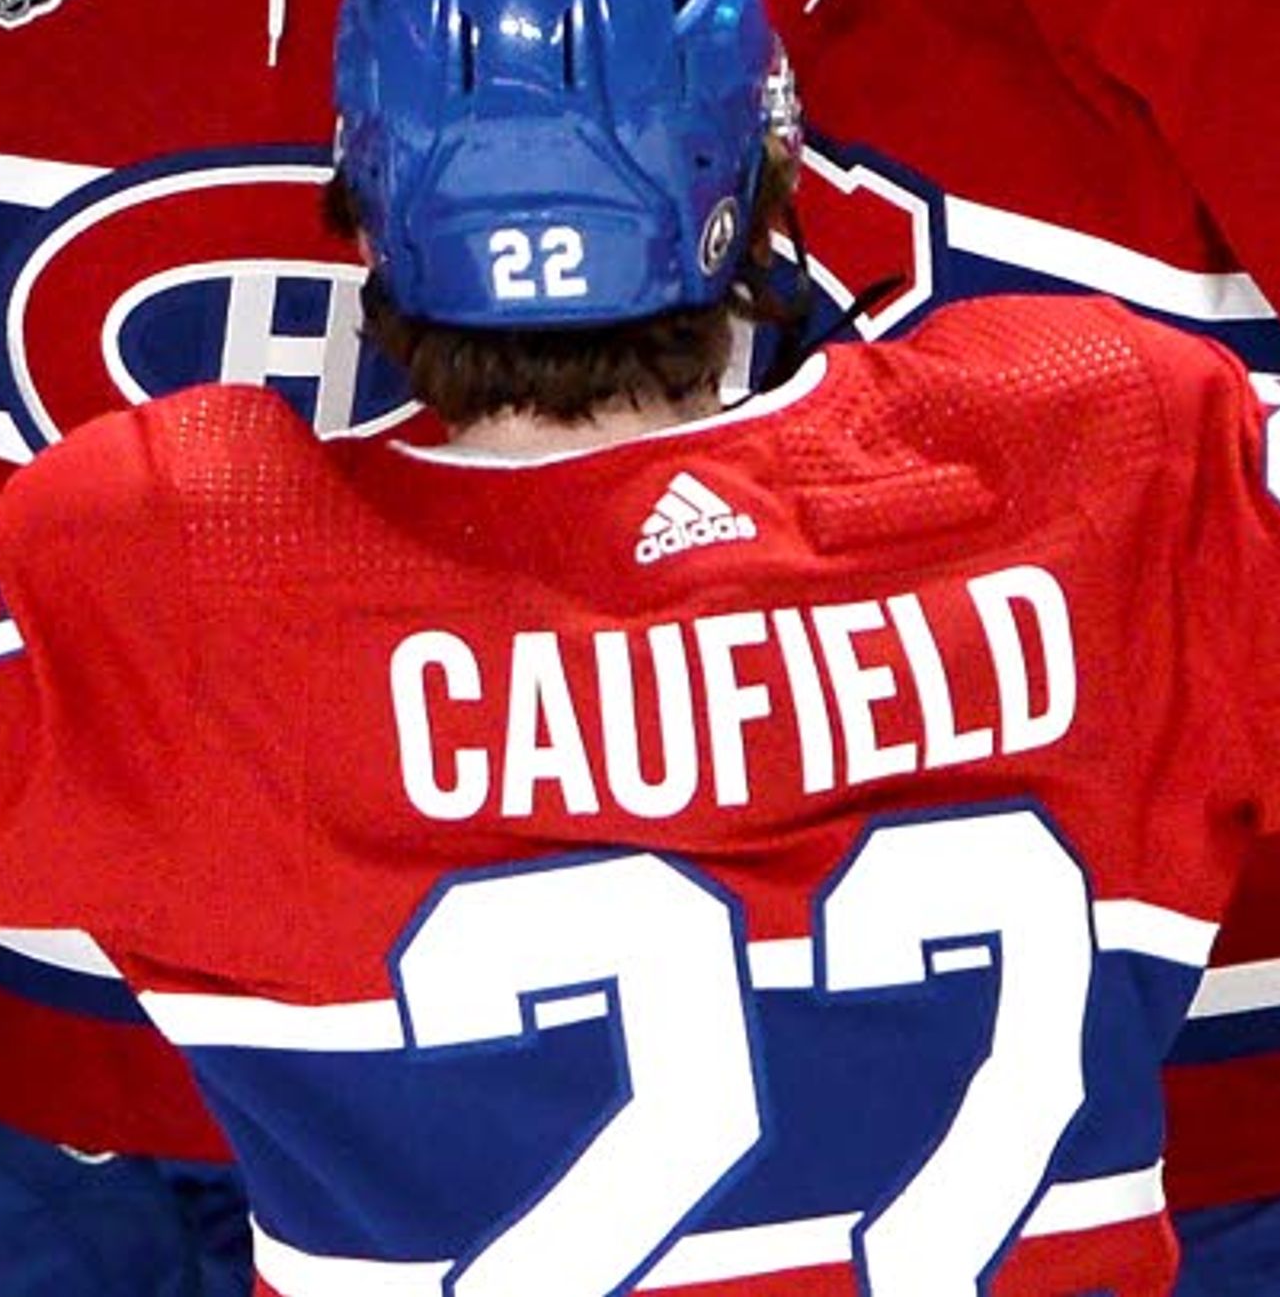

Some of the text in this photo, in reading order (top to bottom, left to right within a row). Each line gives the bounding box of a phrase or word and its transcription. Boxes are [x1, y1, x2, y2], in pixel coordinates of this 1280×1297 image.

[489, 227, 588, 300] 22
[634, 508, 757, 565] adidas
[388, 564, 1078, 820] CAUFIELD
[388, 795, 1096, 1297] 22
